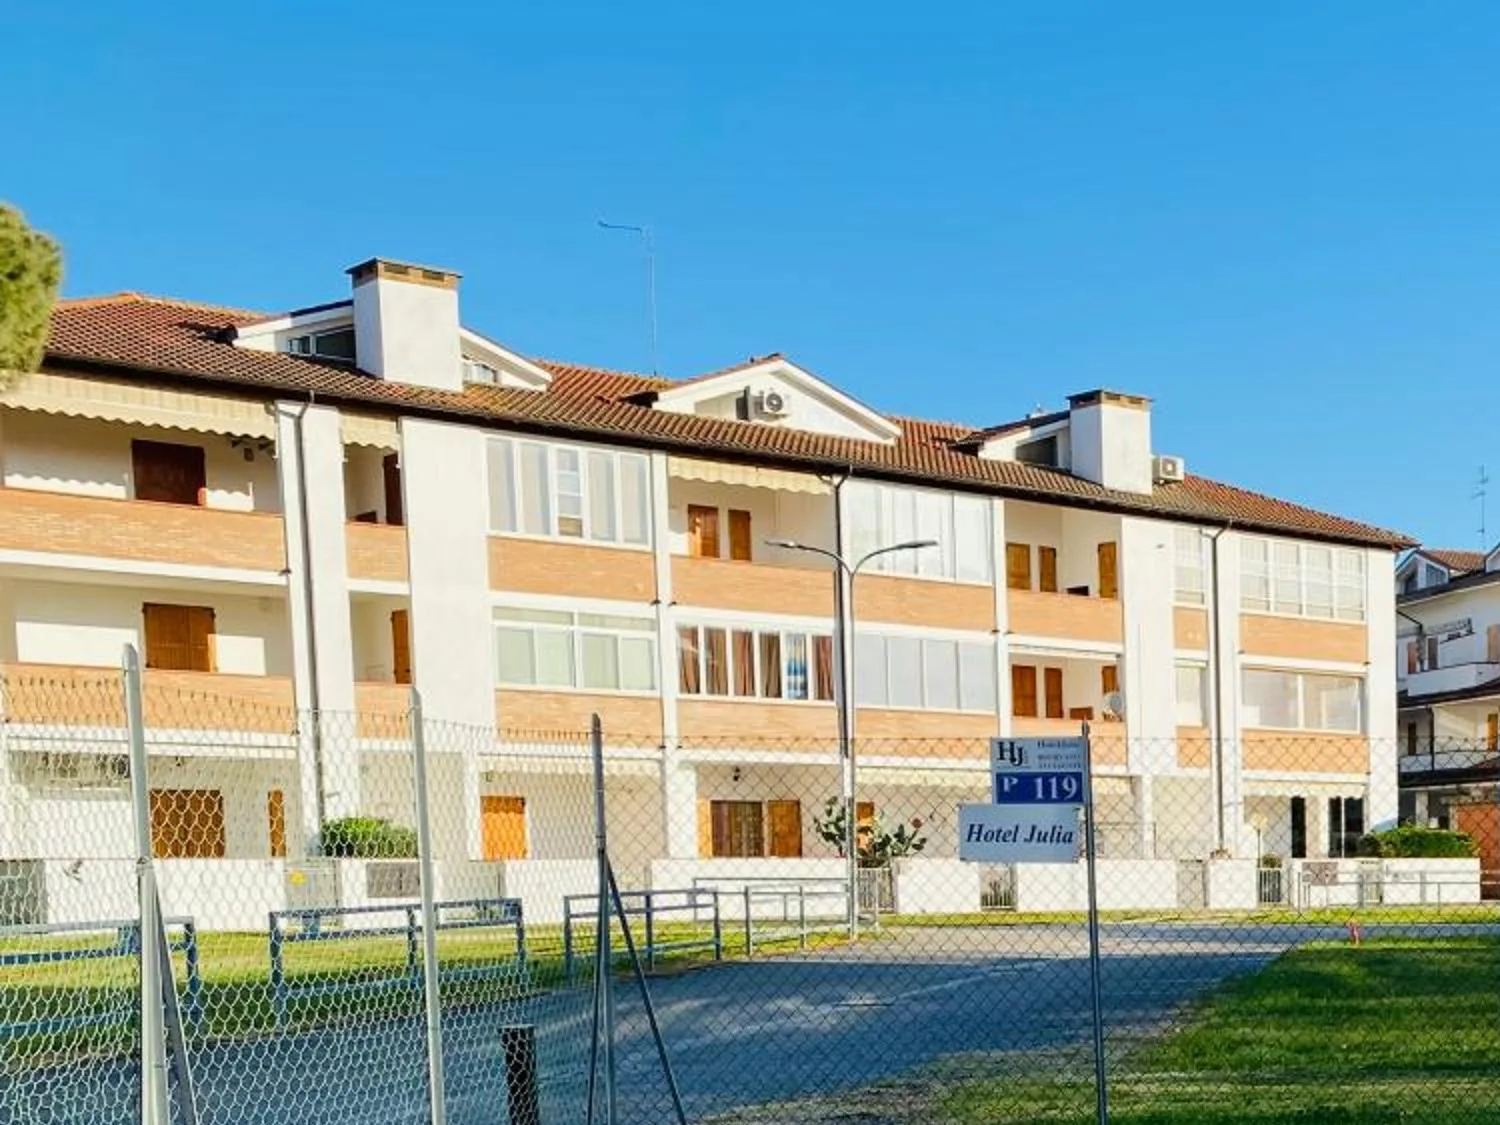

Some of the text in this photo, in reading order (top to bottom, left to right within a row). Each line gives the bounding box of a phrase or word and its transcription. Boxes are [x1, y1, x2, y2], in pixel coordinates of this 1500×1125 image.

[1001, 775, 1078, 800] P 119
[966, 823, 1074, 845] Hotel Julia
